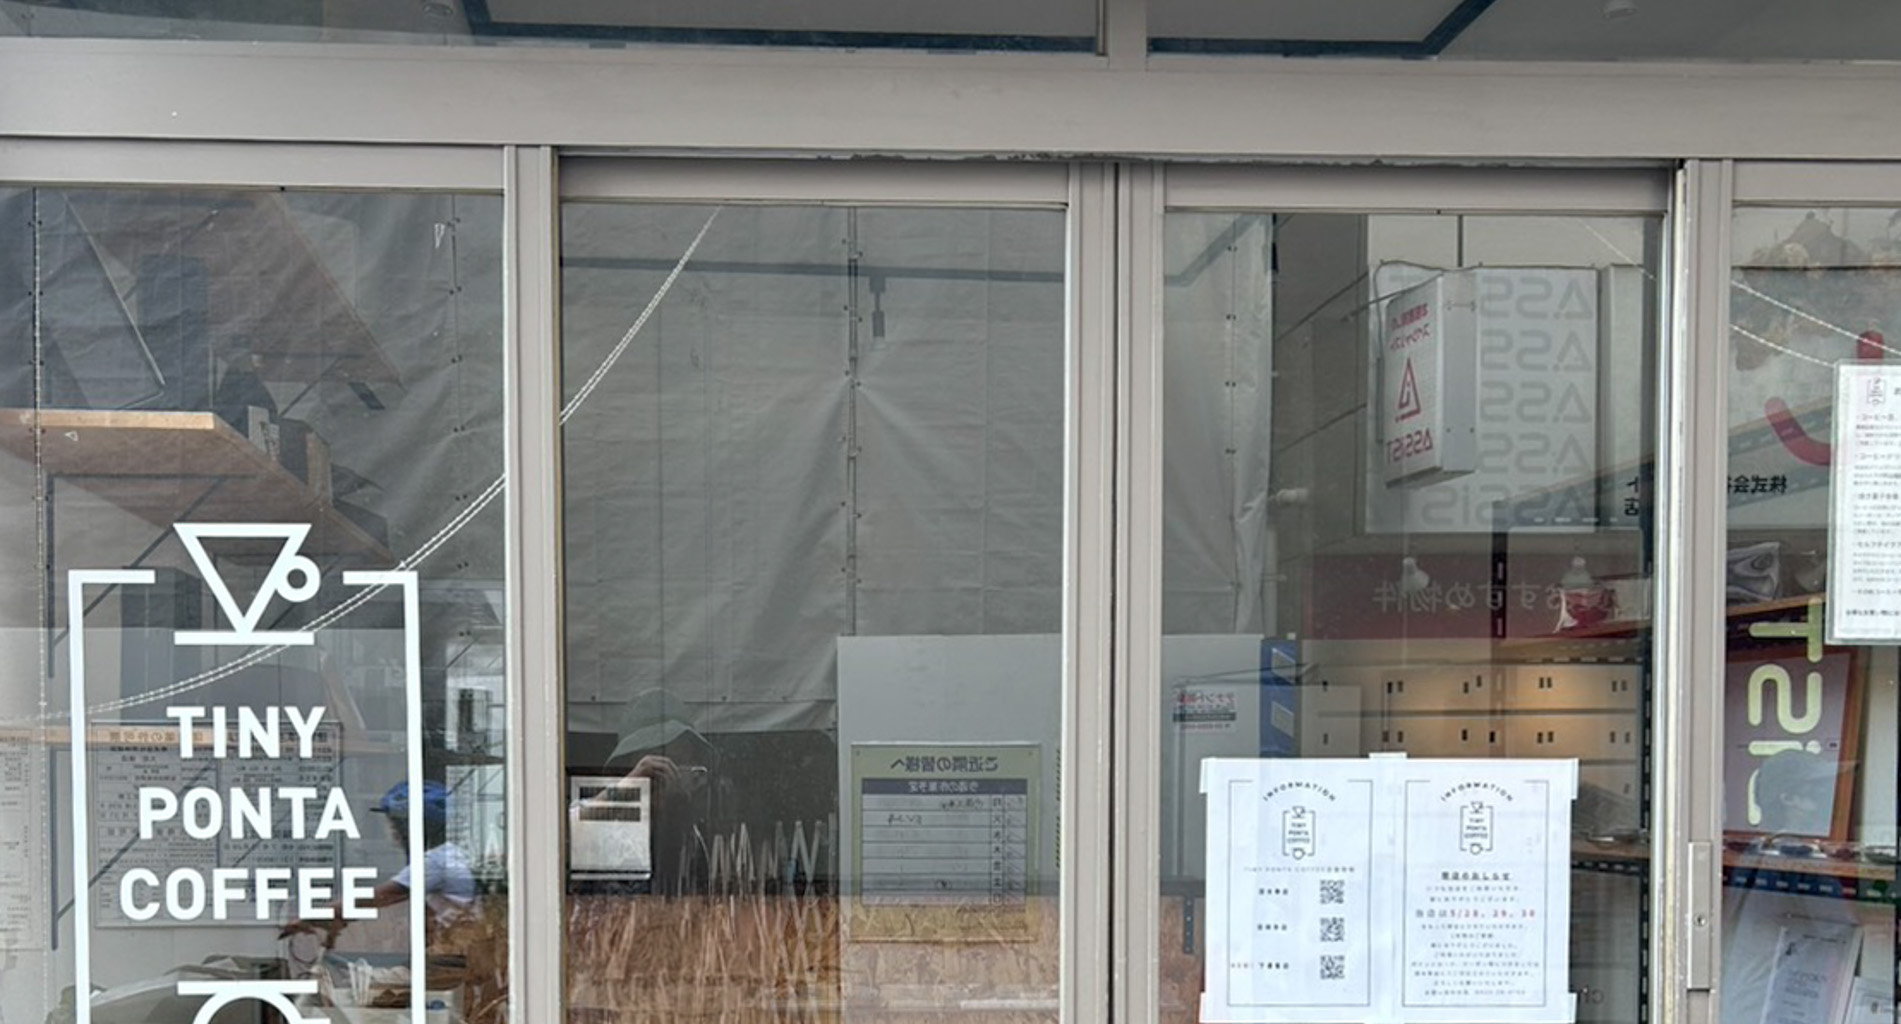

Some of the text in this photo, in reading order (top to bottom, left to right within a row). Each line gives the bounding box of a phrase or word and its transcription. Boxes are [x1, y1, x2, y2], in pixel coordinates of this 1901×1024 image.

[167, 706, 325, 758] TINY
[138, 787, 360, 840] PONTA
[1263, 781, 1336, 802] INFORMATION
[1441, 781, 1513, 802] INFORMATION
[119, 865, 378, 920] COFFEE
